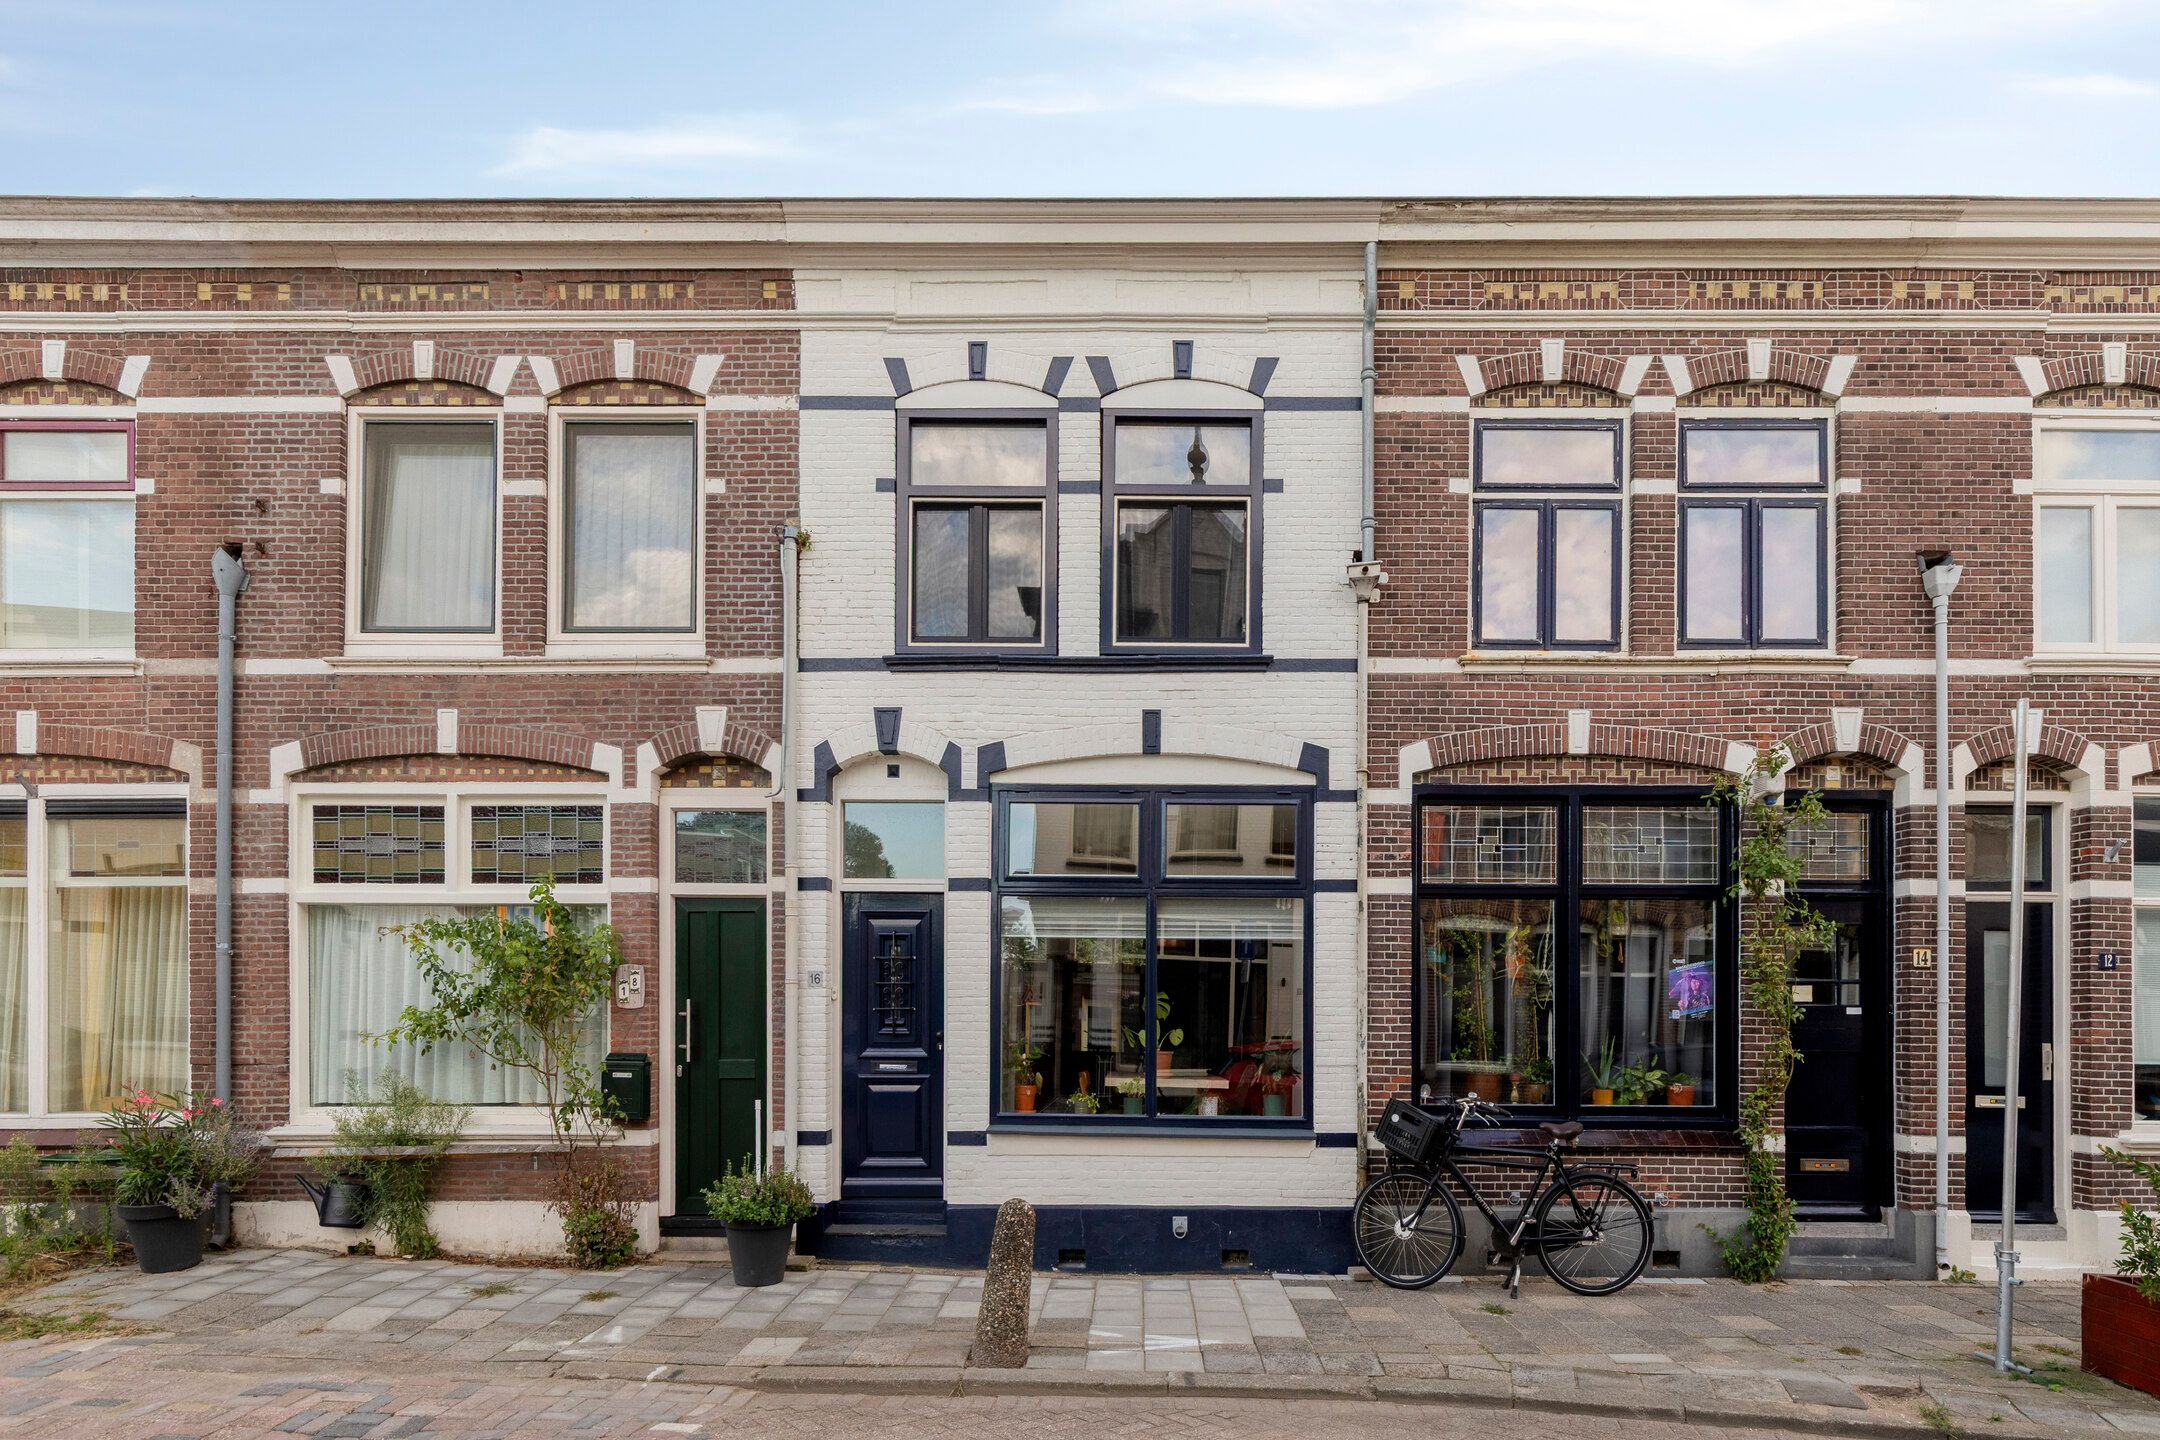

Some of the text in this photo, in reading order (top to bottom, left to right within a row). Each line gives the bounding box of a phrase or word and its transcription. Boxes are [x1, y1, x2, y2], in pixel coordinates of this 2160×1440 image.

[1915, 950, 1929, 966] 14
[2104, 954, 2113, 967] 12
[809, 973, 821, 984] 16
